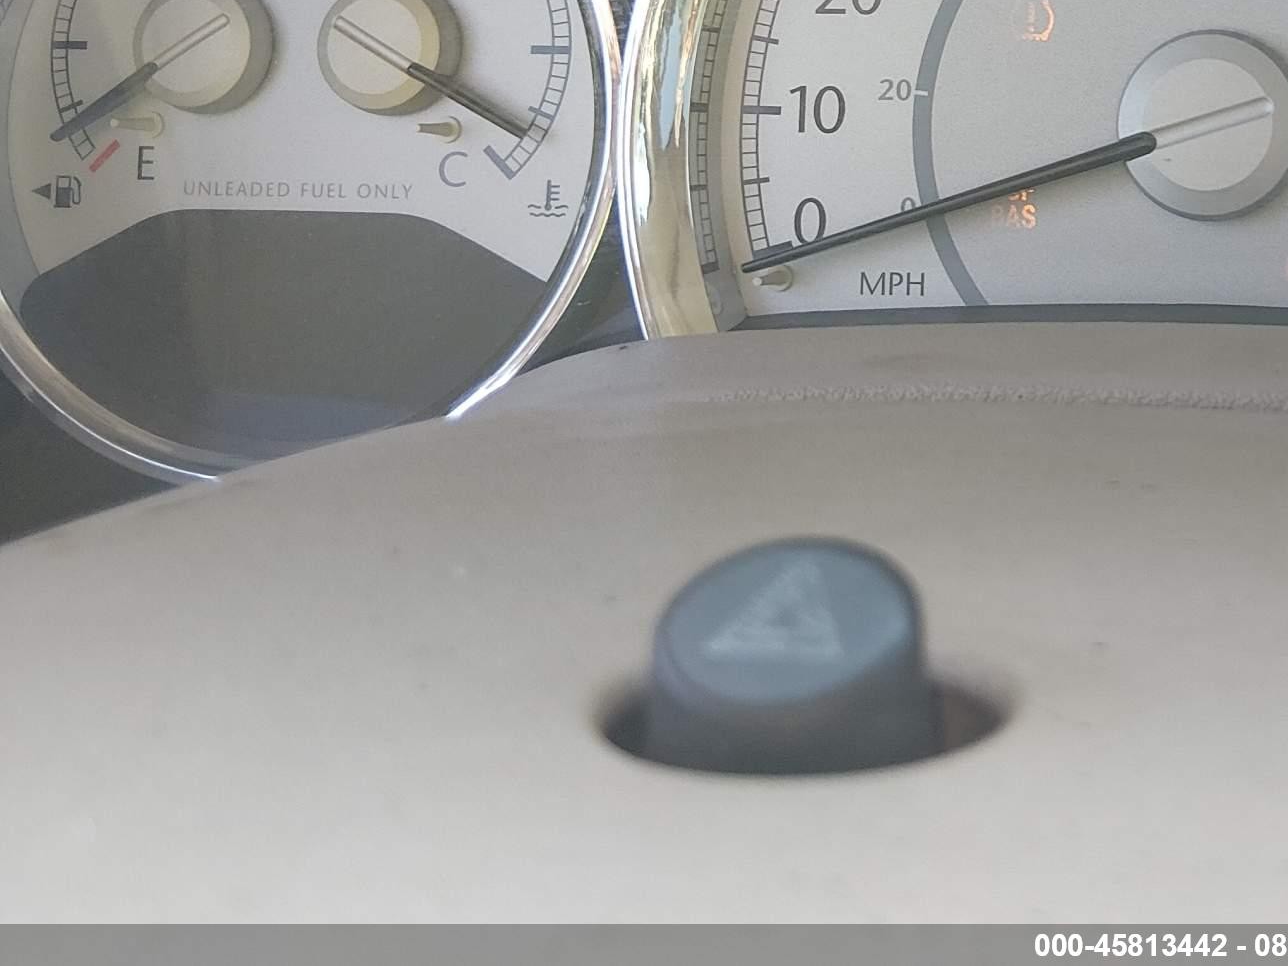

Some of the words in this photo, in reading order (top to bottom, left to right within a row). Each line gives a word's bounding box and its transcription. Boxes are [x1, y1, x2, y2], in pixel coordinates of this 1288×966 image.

[878, 78, 912, 101] 20
[789, 85, 845, 134] 10
[137, 146, 154, 180] E
[439, 151, 468, 188] C
[183, 179, 290, 198] UNLEADED
[300, 181, 347, 199] FUEL
[357, 183, 413, 200] ONLY
[793, 197, 827, 244] 0
[860, 271, 925, 297] MPH
